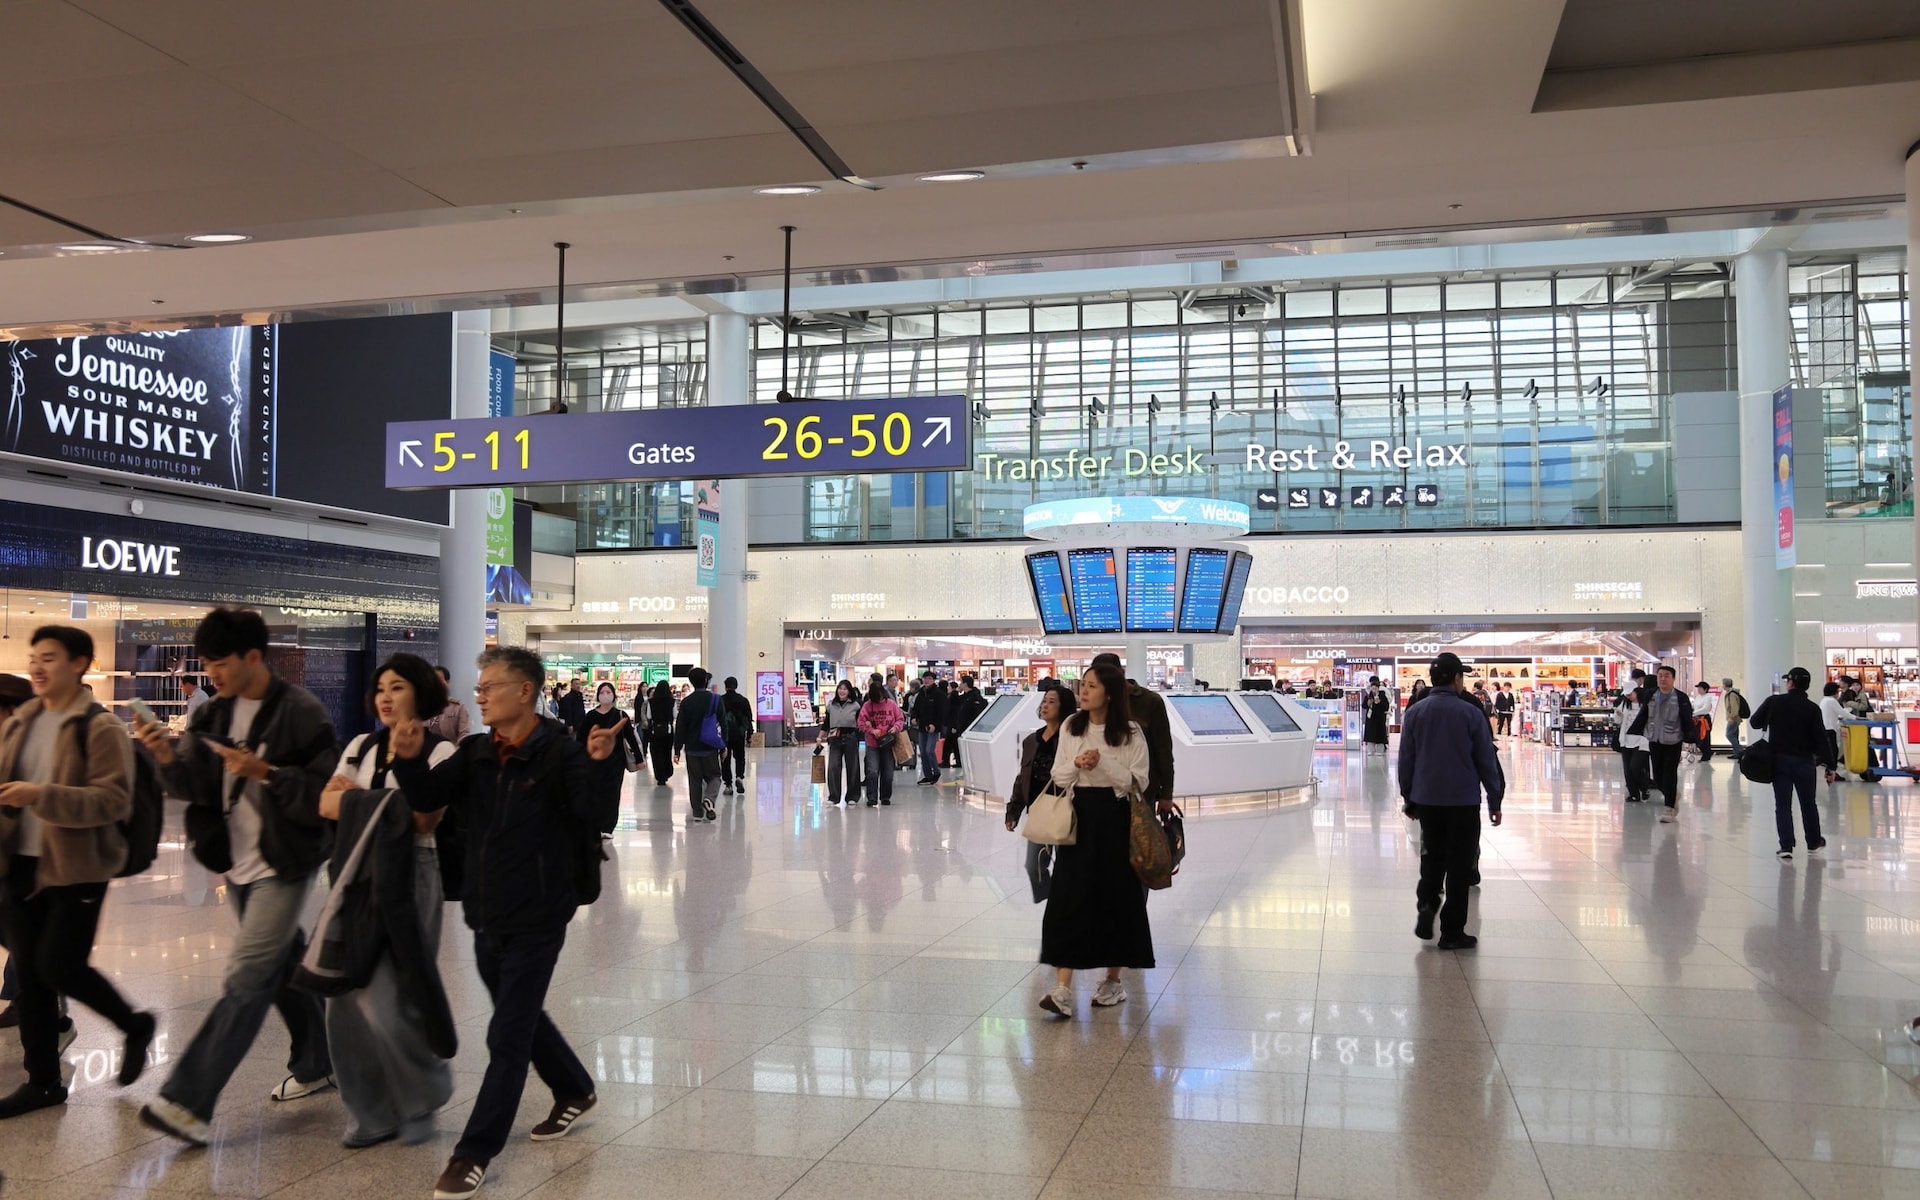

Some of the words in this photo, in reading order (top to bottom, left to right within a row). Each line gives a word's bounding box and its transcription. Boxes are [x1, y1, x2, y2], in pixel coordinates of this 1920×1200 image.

[106, 336, 165, 362] QUALITY
[55, 336, 208, 405] Tennessee
[262, 347, 271, 398] AGED
[67, 385, 128, 408] SOUR
[138, 400, 198, 422] MASH
[41, 400, 219, 460] WHISKEY
[262, 405, 270, 444] AND
[762, 411, 912, 461] 26-50
[62, 444, 116, 463] DISTILLED
[120, 454, 141, 467] AND
[145, 458, 188, 473] BOTTLED
[190, 465, 202, 476] BY
[433, 429, 532, 472] 5-11
[628, 442, 695, 465] Gates
[978, 448, 1112, 482] Transfer
[1125, 443, 1204, 476] Desk
[1245, 443, 1318, 473] Rest
[1332, 441, 1356, 470] &
[1369, 437, 1468, 469] Relax
[1201, 503, 1249, 525] Welcome
[82, 536, 181, 576] LOEWE
[831, 593, 886, 602] SHINSEGAE
[1246, 586, 1350, 604] TOBACCO
[1574, 582, 1643, 592] SHINSEGAE
[1574, 592, 1604, 600] DUTY
[1612, 592, 1643, 600] FREE
[1856, 584, 1889, 599] JUNG
[628, 596, 676, 612] FOOD
[1020, 645, 1052, 655] FOOD
[1306, 649, 1347, 660] LIQUOR
[1404, 643, 1441, 653] FOOD
